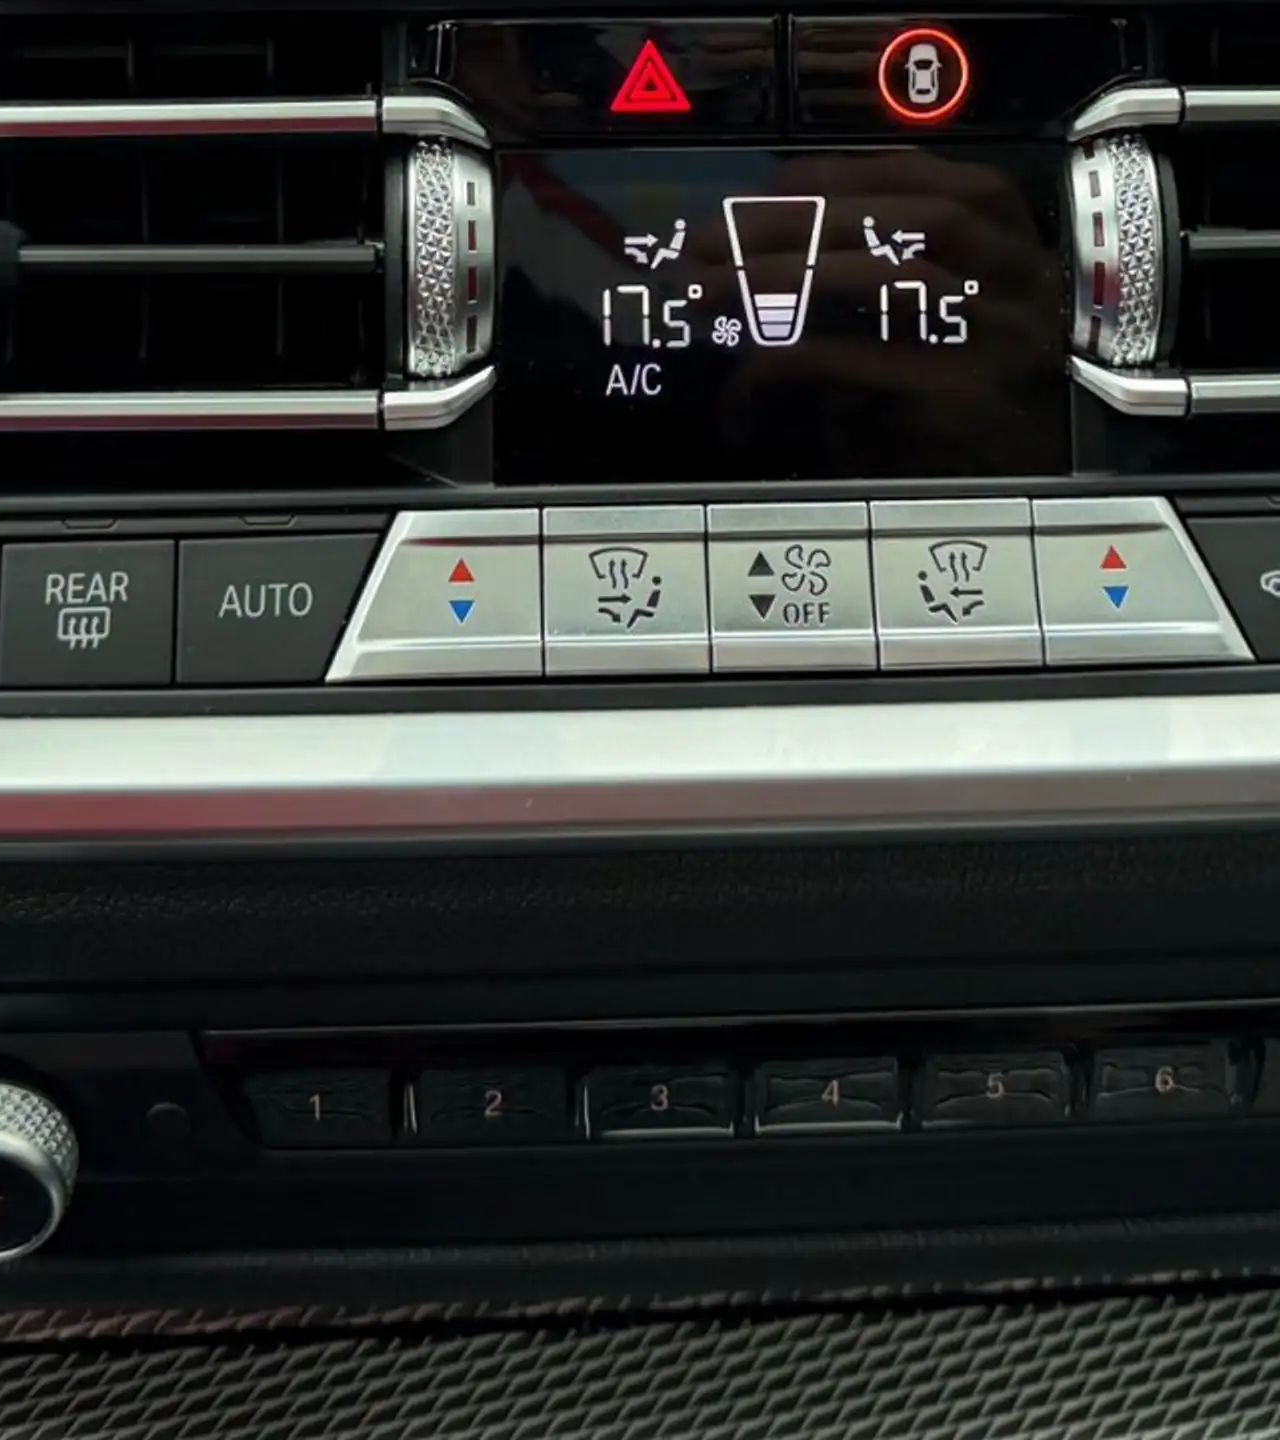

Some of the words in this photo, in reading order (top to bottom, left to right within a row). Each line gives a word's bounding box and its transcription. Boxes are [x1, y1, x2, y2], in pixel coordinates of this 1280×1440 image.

[605, 363, 662, 396] A/C
[45, 571, 129, 604] REAR
[218, 582, 313, 618] AUTO
[782, 602, 829, 624] OFF
[821, 1079, 839, 1105] 4
[985, 1072, 1005, 1099] 5
[1155, 1066, 1174, 1093] 6
[309, 1094, 320, 1121] 1
[484, 1090, 502, 1117] 2
[650, 1084, 669, 1111] 3
